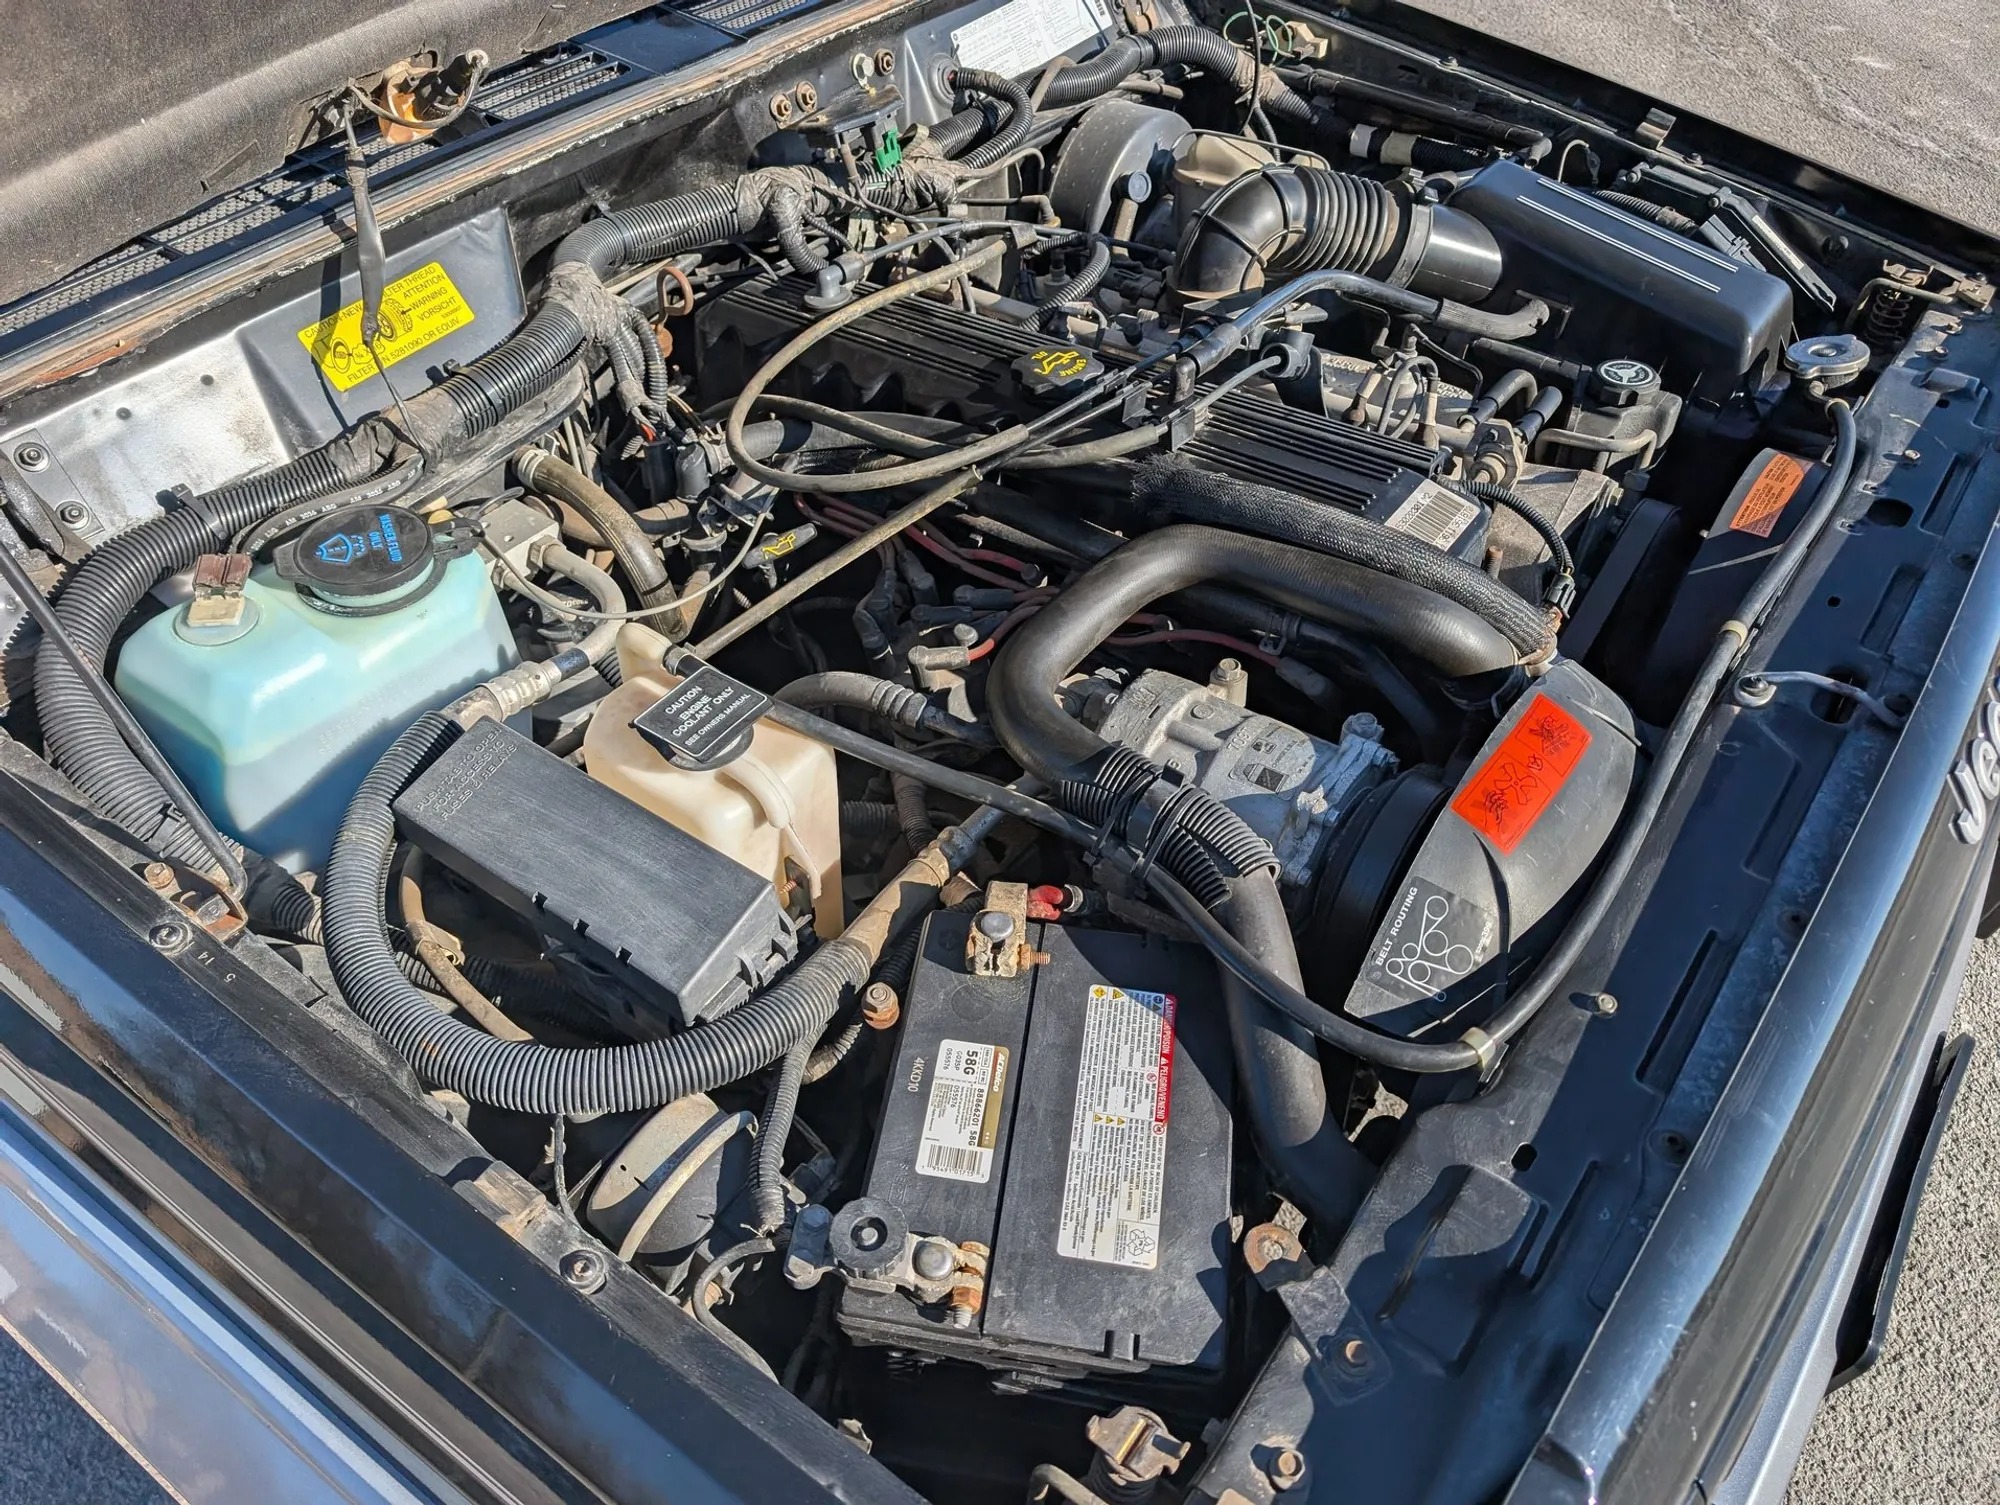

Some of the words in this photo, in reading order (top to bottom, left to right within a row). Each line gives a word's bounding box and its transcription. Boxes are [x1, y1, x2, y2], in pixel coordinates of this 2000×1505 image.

[380, 281, 406, 299] ILTER
[403, 265, 437, 287] THREAD
[401, 272, 445, 300] ATTENTION
[409, 285, 448, 311] WARNING
[416, 294, 458, 322] VORSICHT
[346, 362, 375, 382] FILTER
[389, 336, 424, 360] 5281090
[421, 328, 438, 341] OR
[368, 530, 383, 550] ONLY
[378, 513, 396, 542] WASHER
[387, 540, 403, 562] FLUID
[663, 685, 703, 715] CAUTION
[670, 703, 714, 737] COOLANT
[709, 685, 736, 705] ONLY
[677, 694, 712, 720] ENGINE
[683, 733, 701, 746] SEE
[696, 712, 727, 735] OWNERS
[722, 692, 751, 714] MANUAL
[414, 783, 445, 811] PUSH
[440, 766, 463, 786] TAB
[458, 752, 476, 768] TO
[473, 726, 502, 753] OPEN
[430, 789, 455, 812] FOR
[451, 751, 494, 791] ACCESS
[488, 738, 506, 754] TO
[439, 788, 474, 820] FUSES
[479, 743, 519, 780] RELAYS
[1955, 700, 2000, 845] Je
[1375, 940, 1394, 966] BELT
[1390, 886, 1418, 936] ROUTING
[908, 1056, 926, 1092] 4KKD10
[962, 1049, 978, 1075] 58G
[992, 1052, 1005, 1092] ACDelco
[1155, 1065, 1168, 1119] PELIGRO/VENENO
[967, 1130, 977, 1146] 58G
